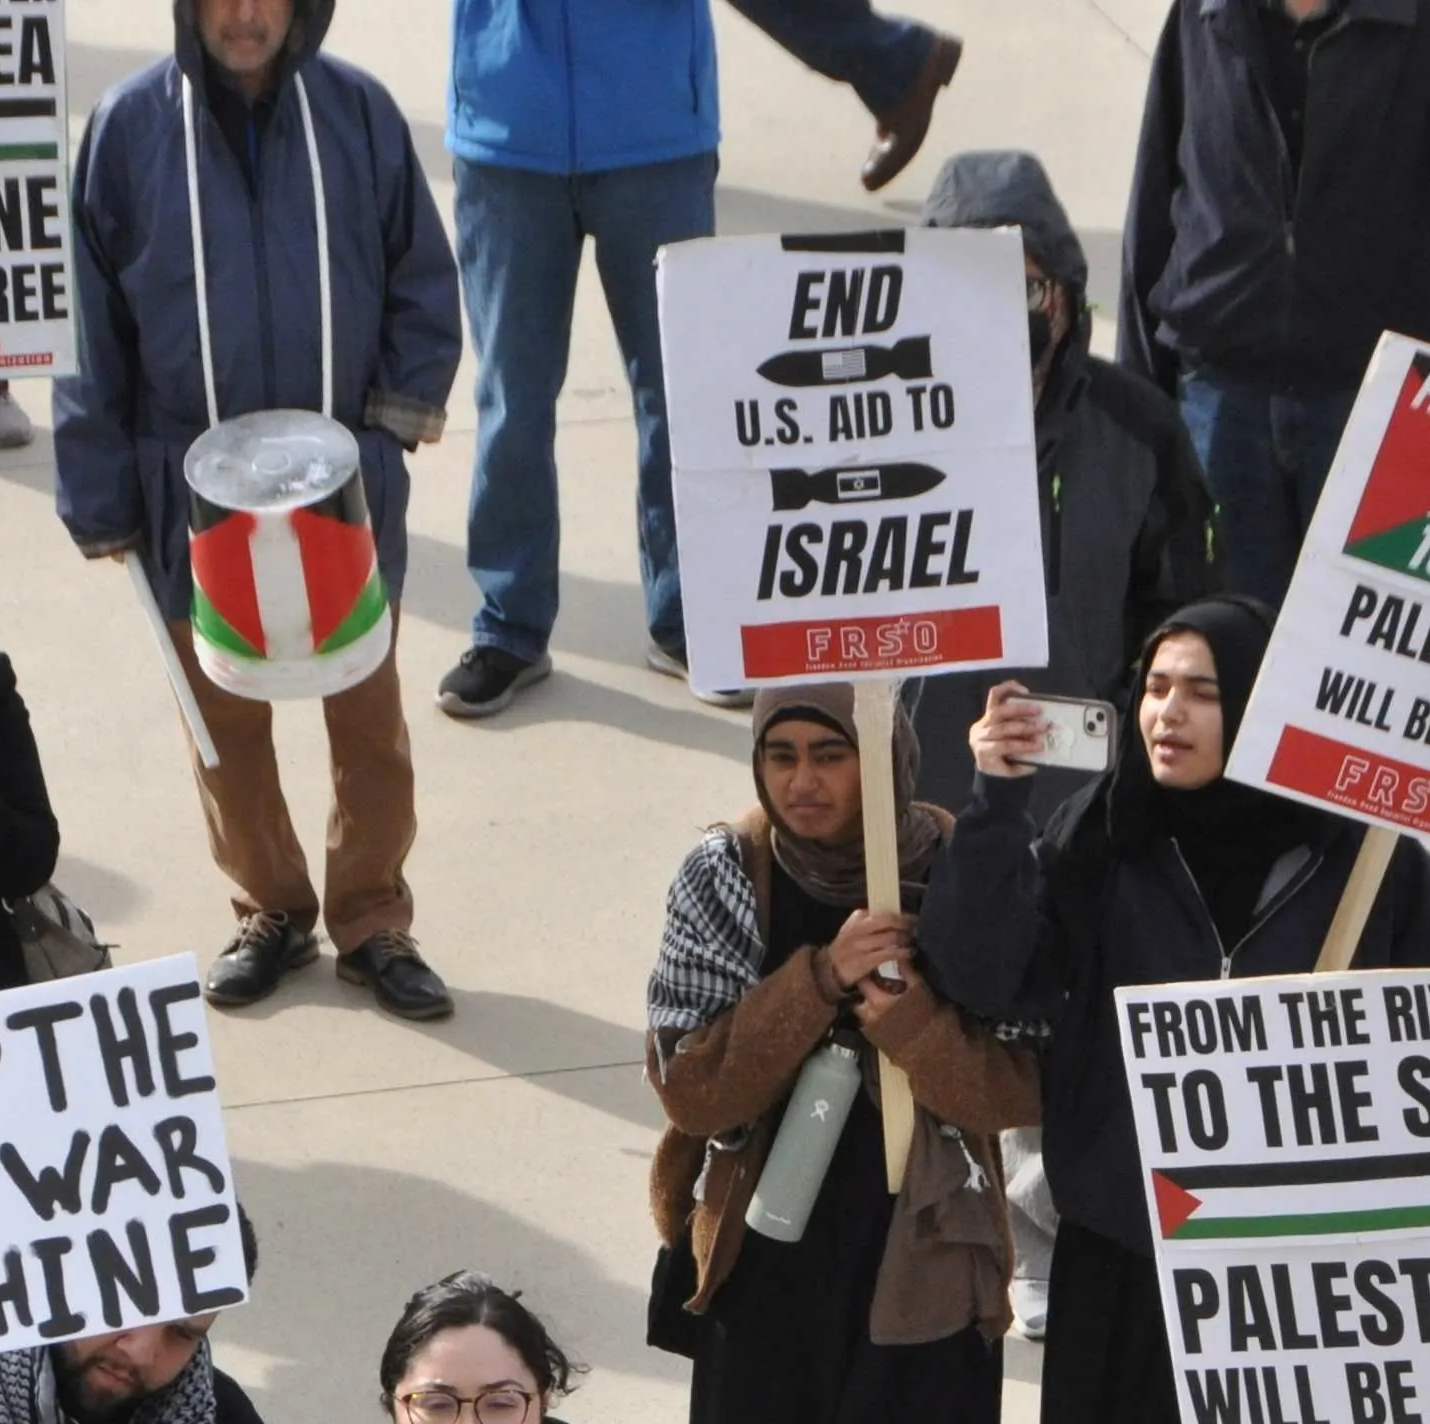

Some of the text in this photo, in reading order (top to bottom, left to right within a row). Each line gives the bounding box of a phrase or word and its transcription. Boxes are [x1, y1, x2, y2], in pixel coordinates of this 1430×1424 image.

[788, 264, 904, 341] END
[735, 384, 955, 447] U.S. AID TO
[756, 508, 981, 602] ISRAEL
[806, 621, 937, 661] FRSO
[1314, 666, 1395, 732] WILL
[6, 980, 216, 1112] THE
[1126, 994, 1268, 1059] FROM
[1279, 988, 1371, 1048] THE
[1142, 1068, 1229, 1154] TO
[1246, 1060, 1379, 1147] THE
